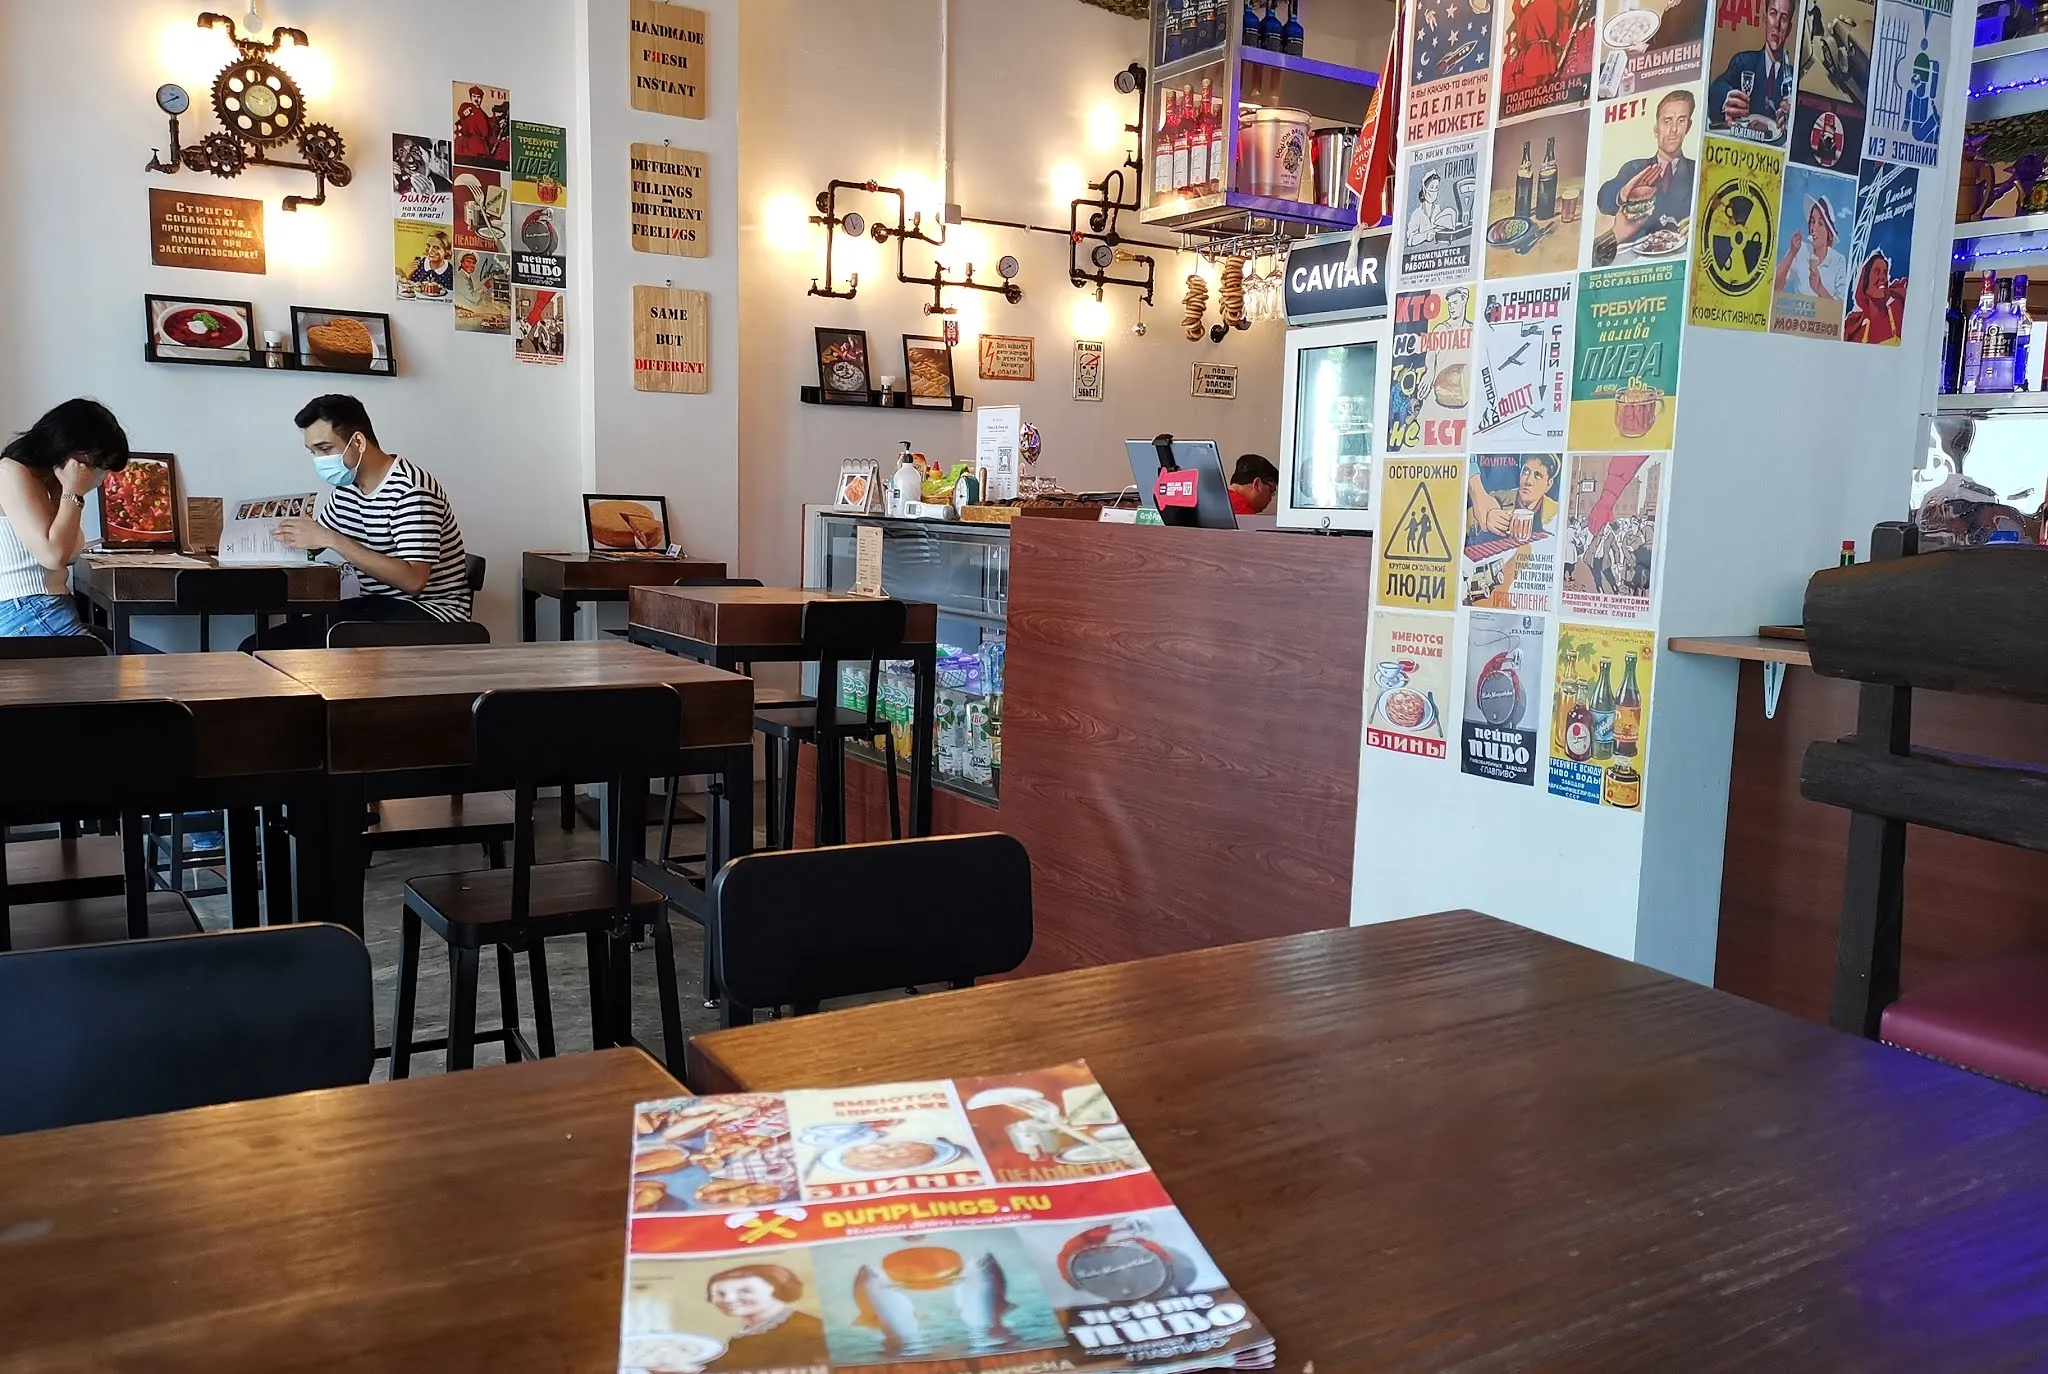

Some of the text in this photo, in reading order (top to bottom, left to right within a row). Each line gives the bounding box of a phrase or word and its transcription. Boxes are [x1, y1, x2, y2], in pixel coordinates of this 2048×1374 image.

[630, 19, 704, 45] HANDMADE
[1628, 43, 1701, 73] ПЕЛЬМЕНИ
[489, 89, 508, 101] ТЫ
[636, 75, 696, 97] INSTANT
[1410, 73, 1489, 100] А ВЫ КАКУЮ-ТО ФИГНЮ
[1506, 77, 1583, 104] ПОДПИСАЛСЯ НА
[1409, 88, 1487, 120] СДЕЛАТЬ
[1505, 90, 1569, 115] DUMPLINGS.RU
[1604, 98, 1647, 124] НЕТ!
[1408, 110, 1485, 142] НЕ МОЖЕТЕ
[517, 136, 559, 149] ТРЕБУЙТЕ
[1868, 136, 1938, 166] ИЗ ЭСТОНИИ
[516, 156, 560, 177] ПИВА
[630, 157, 702, 178] DIFFERENT
[1444, 157, 1475, 179] ГРИППА
[1706, 145, 1780, 176] ОСТОРОЖНО
[633, 180, 693, 198] FILLINGS
[165, 213, 246, 228] СОБЛЮДАЙТЕ
[631, 201, 703, 221] DIFFERENT
[161, 224, 253, 239] ПРОТИВОПОЖАРНЫЕ
[171, 235, 242, 248] ПРАВИЛА ПРИ
[1404, 254, 1467, 272] РАБОТАТЬ В МАСКЕ
[1410, 248, 1461, 262] РЕКОМЕНДУЕТСЯ
[1291, 257, 1378, 294] CAVIAR
[1589, 272, 1673, 289] РОСГЛАВПИВО
[1502, 282, 1572, 307] ТРУДОВОЙ
[650, 306, 688, 321] SAME
[1395, 293, 1441, 324] КТО
[1489, 301, 1560, 322] НАРОД
[1591, 296, 1668, 319] ТРЕБУЙТЕ
[1692, 305, 1767, 326] КОФЕАКТИВНОСТЬ
[656, 333, 683, 346] BUT
[1420, 328, 1473, 353] РАБОТАЕТ
[1599, 322, 1650, 343] налива
[635, 358, 704, 374] DIFFERENT
[1580, 342, 1664, 382] ПИВА
[1393, 364, 1426, 396] ТОТ
[1497, 383, 1535, 418] ФЛОТ
[1424, 419, 1467, 446] ЕСТ
[1388, 465, 1458, 479] ОСТОРОЖНО
[1389, 563, 1446, 573] КРУГОМ СКОЛЬЗКИЕ
[1515, 562, 1553, 571] ТРАНСПОРТОМ
[1516, 553, 1554, 562] УПРАВЛЕНИЕ
[1513, 582, 1546, 591] СОСТОЯНИИ
[1520, 570, 1554, 583] НЕТРЕЗВОМ
[1386, 573, 1446, 604] ЛЮДИ
[1612, 611, 1636, 619] СЛУХОВ
[1391, 630, 1444, 645] ИМЕЮТСЯ
[1396, 644, 1443, 658] ПРОДАЖЕ
[1367, 730, 1446, 758] БЛИНЫ
[1474, 727, 1523, 745] пейте
[1549, 767, 1601, 785] ПИВО ВОДЫ
[1550, 757, 1602, 776] ТРЕБУЙТЕ ВСЮДУ
[1561, 778, 1585, 789] ЗАВОДОВ
[822, 1195, 1052, 1230] DUMPLINGS.RU
[1077, 1293, 1216, 1325] пейте
